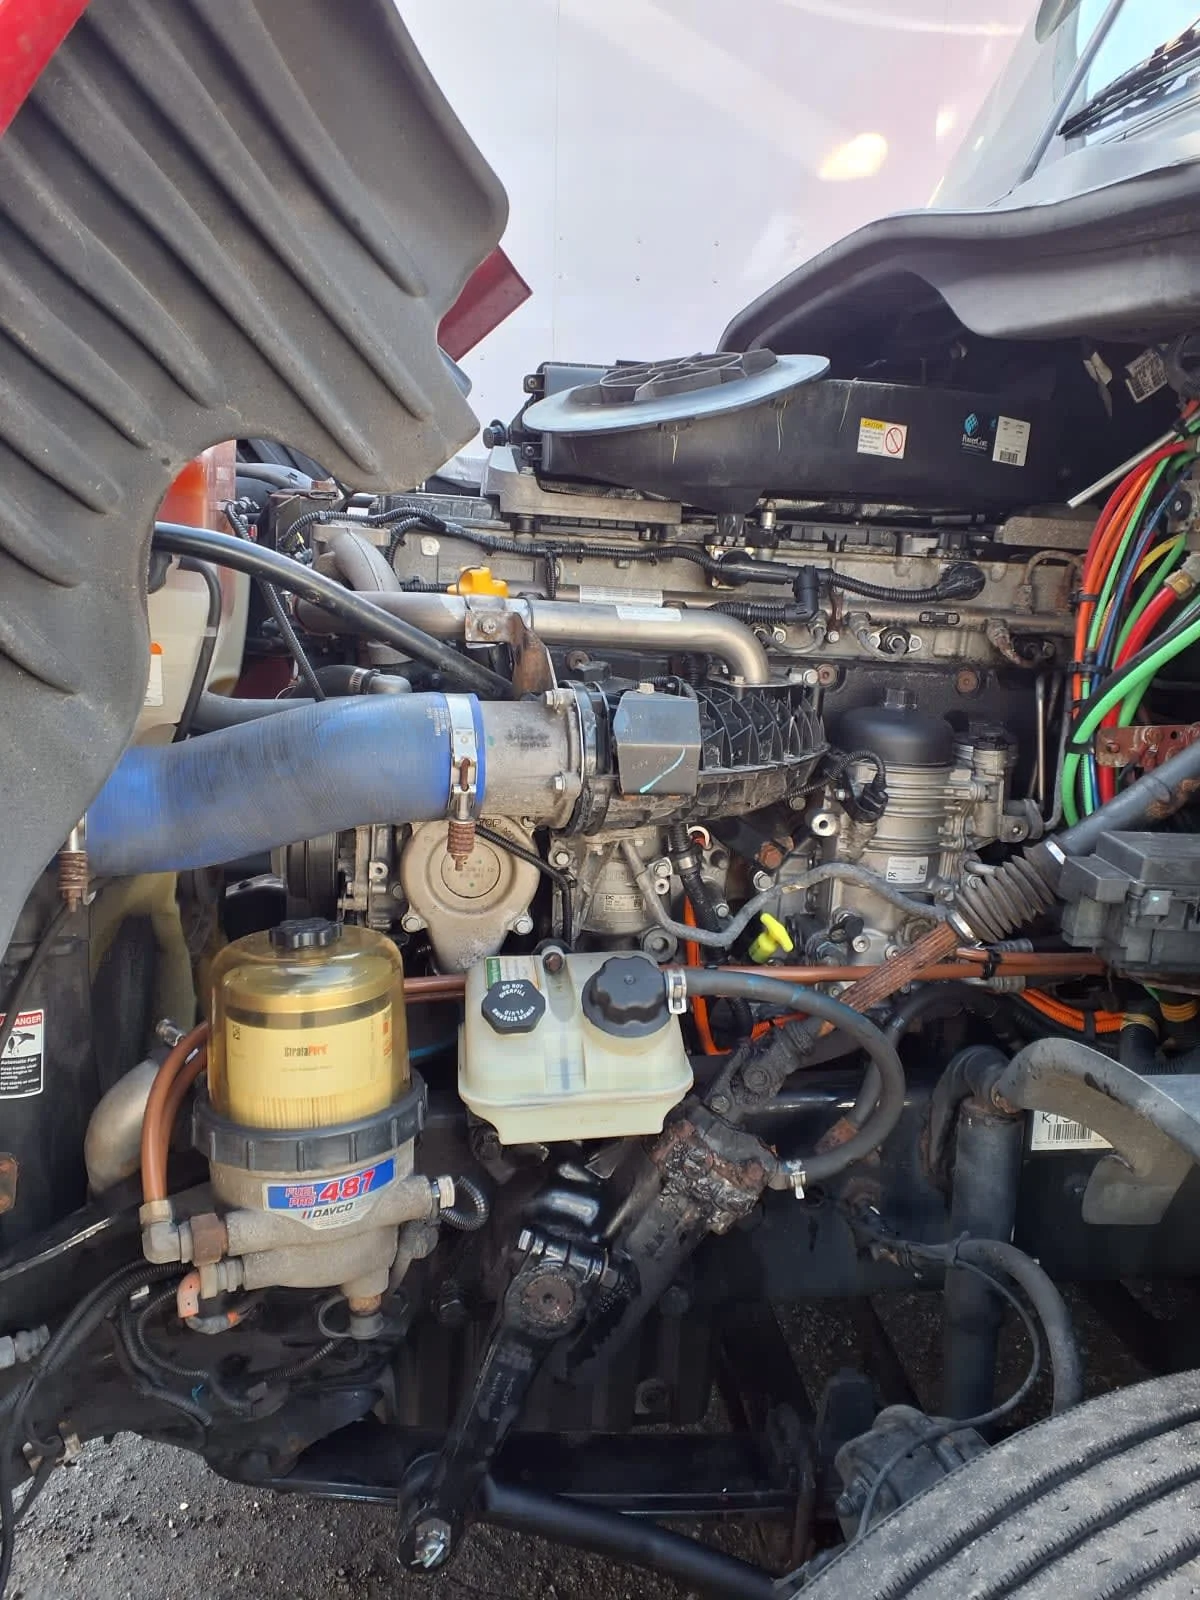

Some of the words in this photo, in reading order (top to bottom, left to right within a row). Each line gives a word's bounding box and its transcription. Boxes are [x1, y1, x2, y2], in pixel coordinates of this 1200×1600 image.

[14, 1014, 41, 1026] ANGER
[285, 1186, 317, 1198] FUEL
[318, 1168, 375, 1204] 487
[289, 1197, 316, 1208] PRO
[312, 1202, 354, 1218] DAVCO
